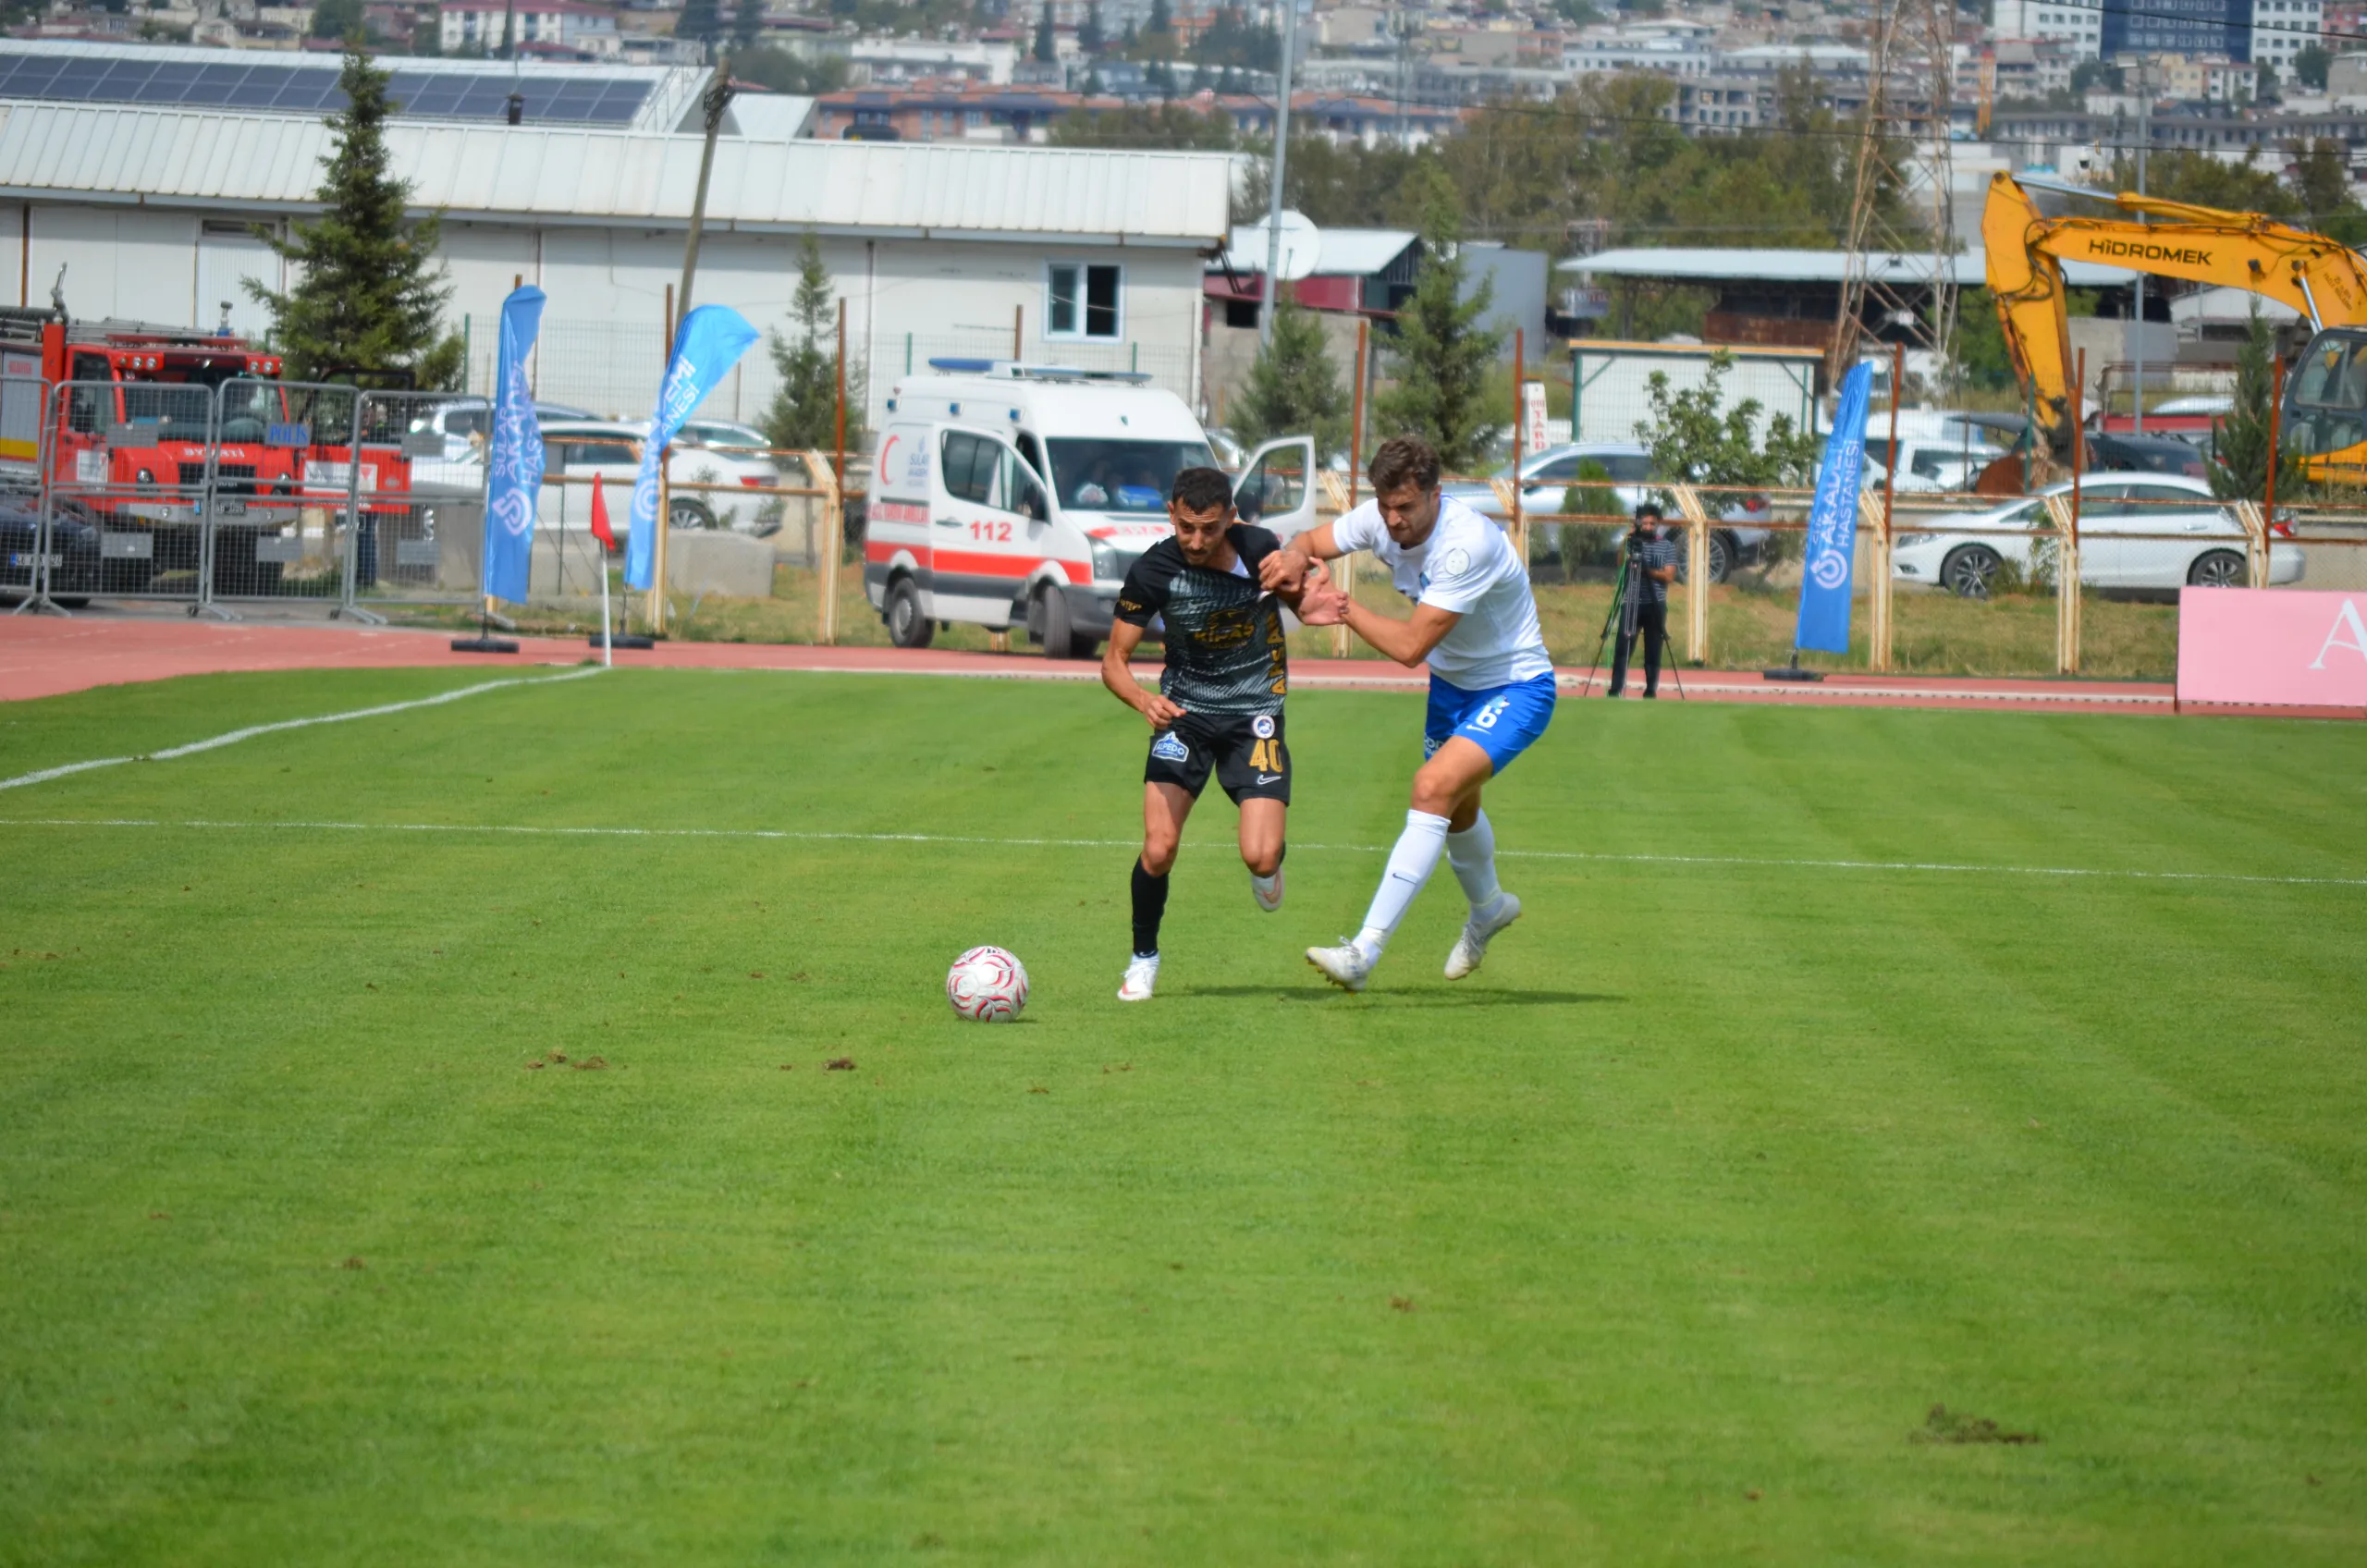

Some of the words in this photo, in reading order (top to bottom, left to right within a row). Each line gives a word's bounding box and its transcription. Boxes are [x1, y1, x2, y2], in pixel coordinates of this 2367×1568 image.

[2089, 239, 2213, 266] HİDROMEK
[970, 520, 1012, 542] 112
[1476, 702, 1502, 729] 6
[1156, 742, 1185, 755] ALPEDO
[1249, 739, 1283, 773] 40
